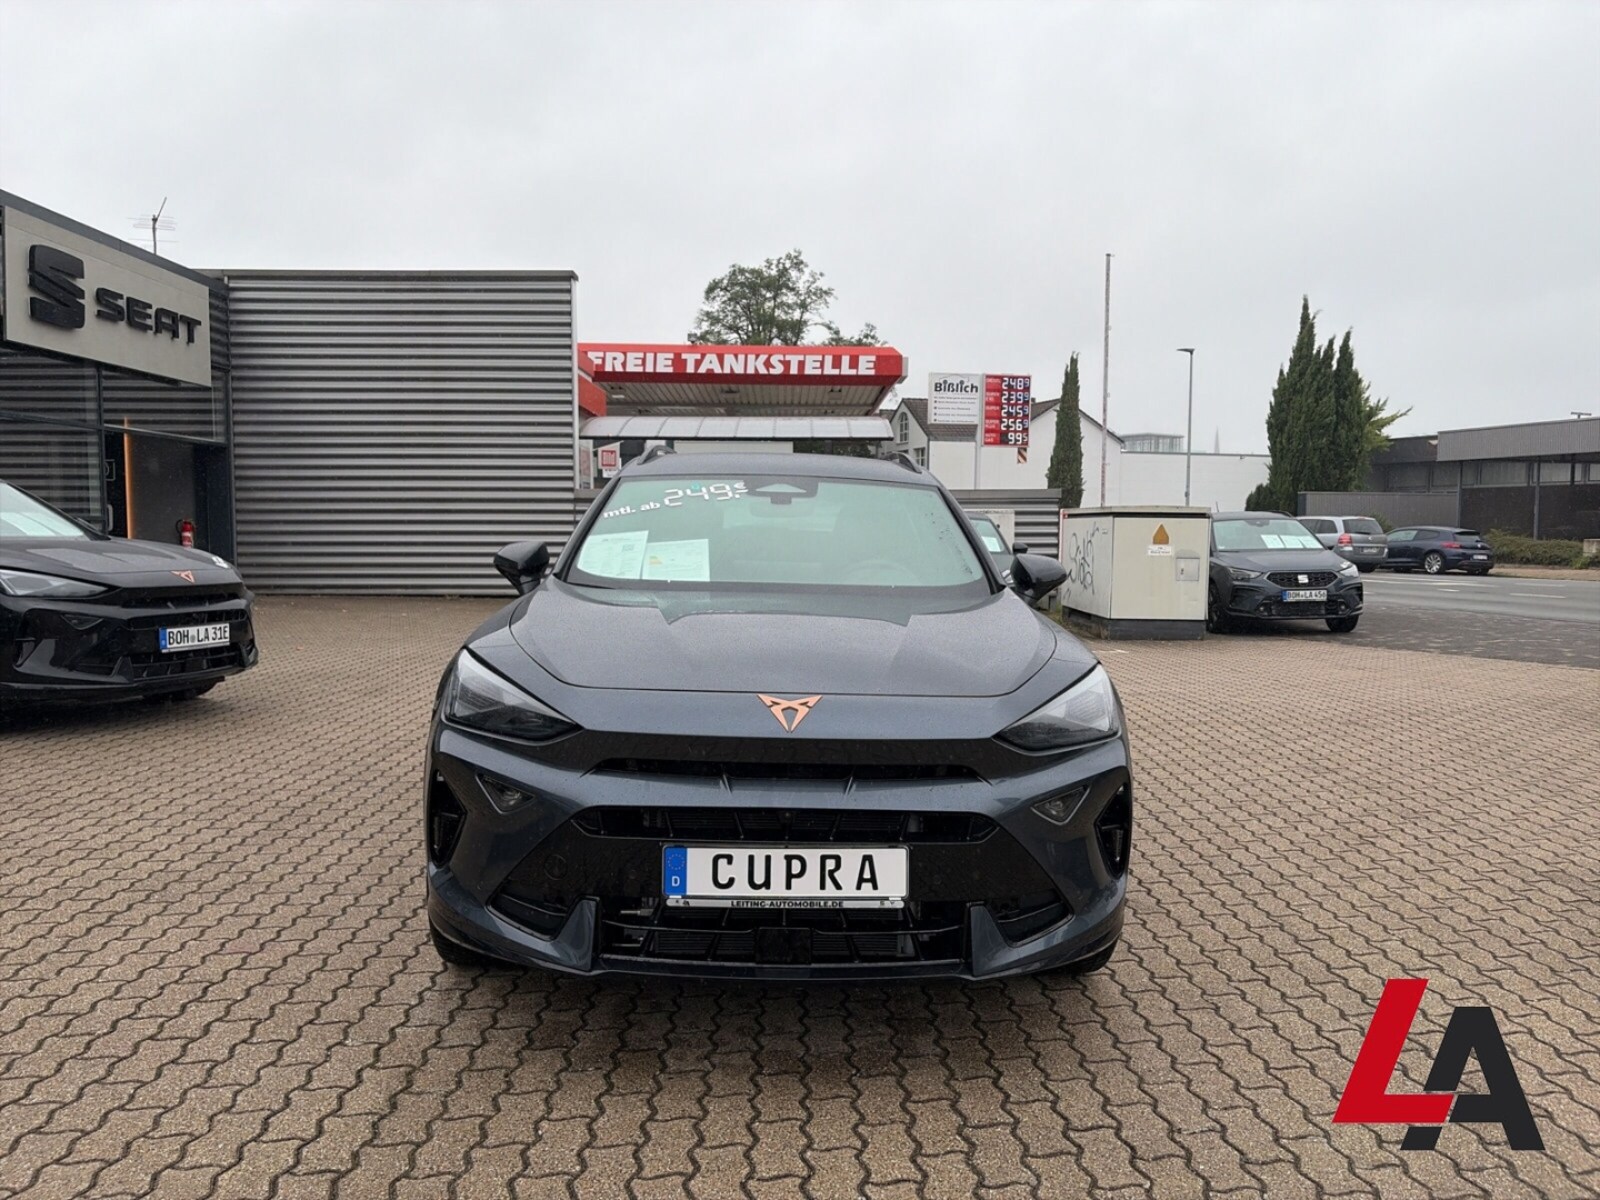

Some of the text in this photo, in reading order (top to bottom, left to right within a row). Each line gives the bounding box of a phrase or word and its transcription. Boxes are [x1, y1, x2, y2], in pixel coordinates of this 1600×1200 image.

[95, 287, 202, 344] SEAT
[587, 351, 876, 375] FREIE TANKSTELLE
[934, 379, 978, 392] Bißlich
[603, 505, 637, 518] mtl.
[640, 501, 661, 511] ab
[168, 625, 229, 646] BOH LA 31E
[671, 876, 681, 887] D
[711, 853, 879, 891] CUPRA
